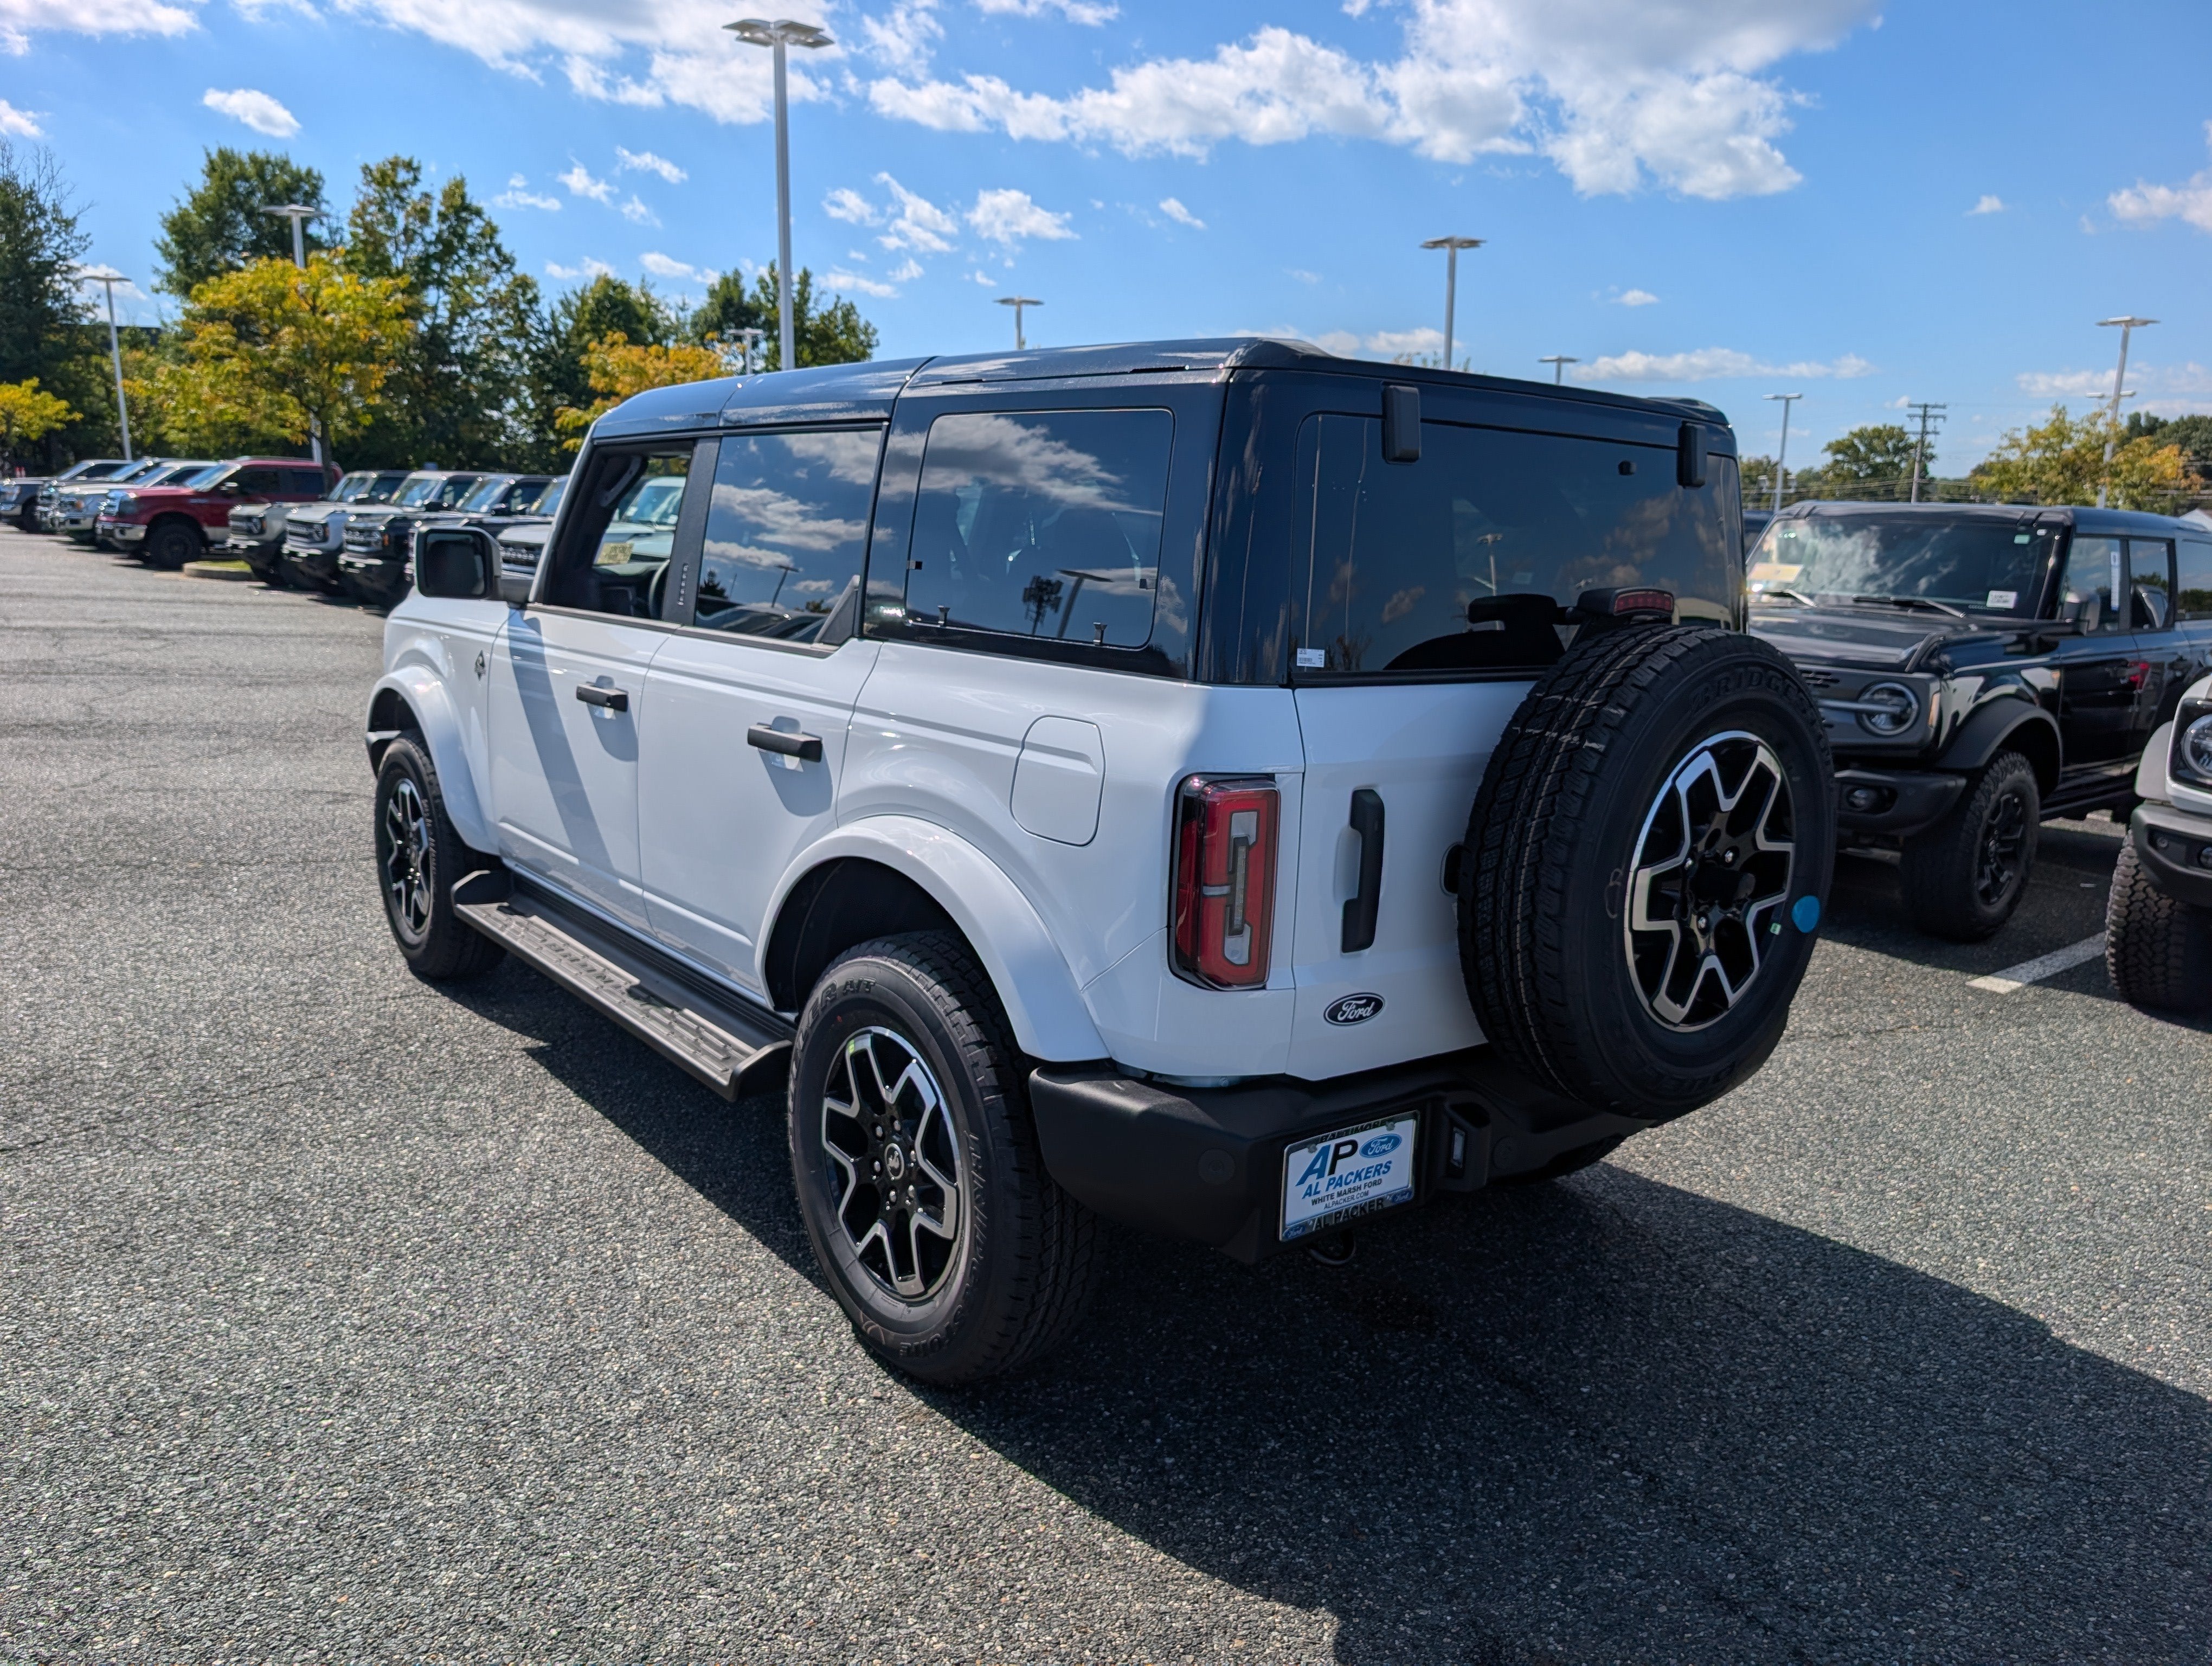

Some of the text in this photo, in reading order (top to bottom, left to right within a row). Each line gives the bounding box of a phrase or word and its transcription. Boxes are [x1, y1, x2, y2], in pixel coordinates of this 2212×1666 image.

[843, 977, 877, 996] A/T
[1337, 998, 1376, 1021] Ford
[1295, 1139, 1358, 1186] AP
[1302, 1159, 1392, 1199] AL PACKERS
[1311, 1178, 1382, 1206] WHITE MARSH FORD
[1312, 1196, 1384, 1232] AL PACKER
[1323, 1190, 1369, 1210] ALPACKER.COM
